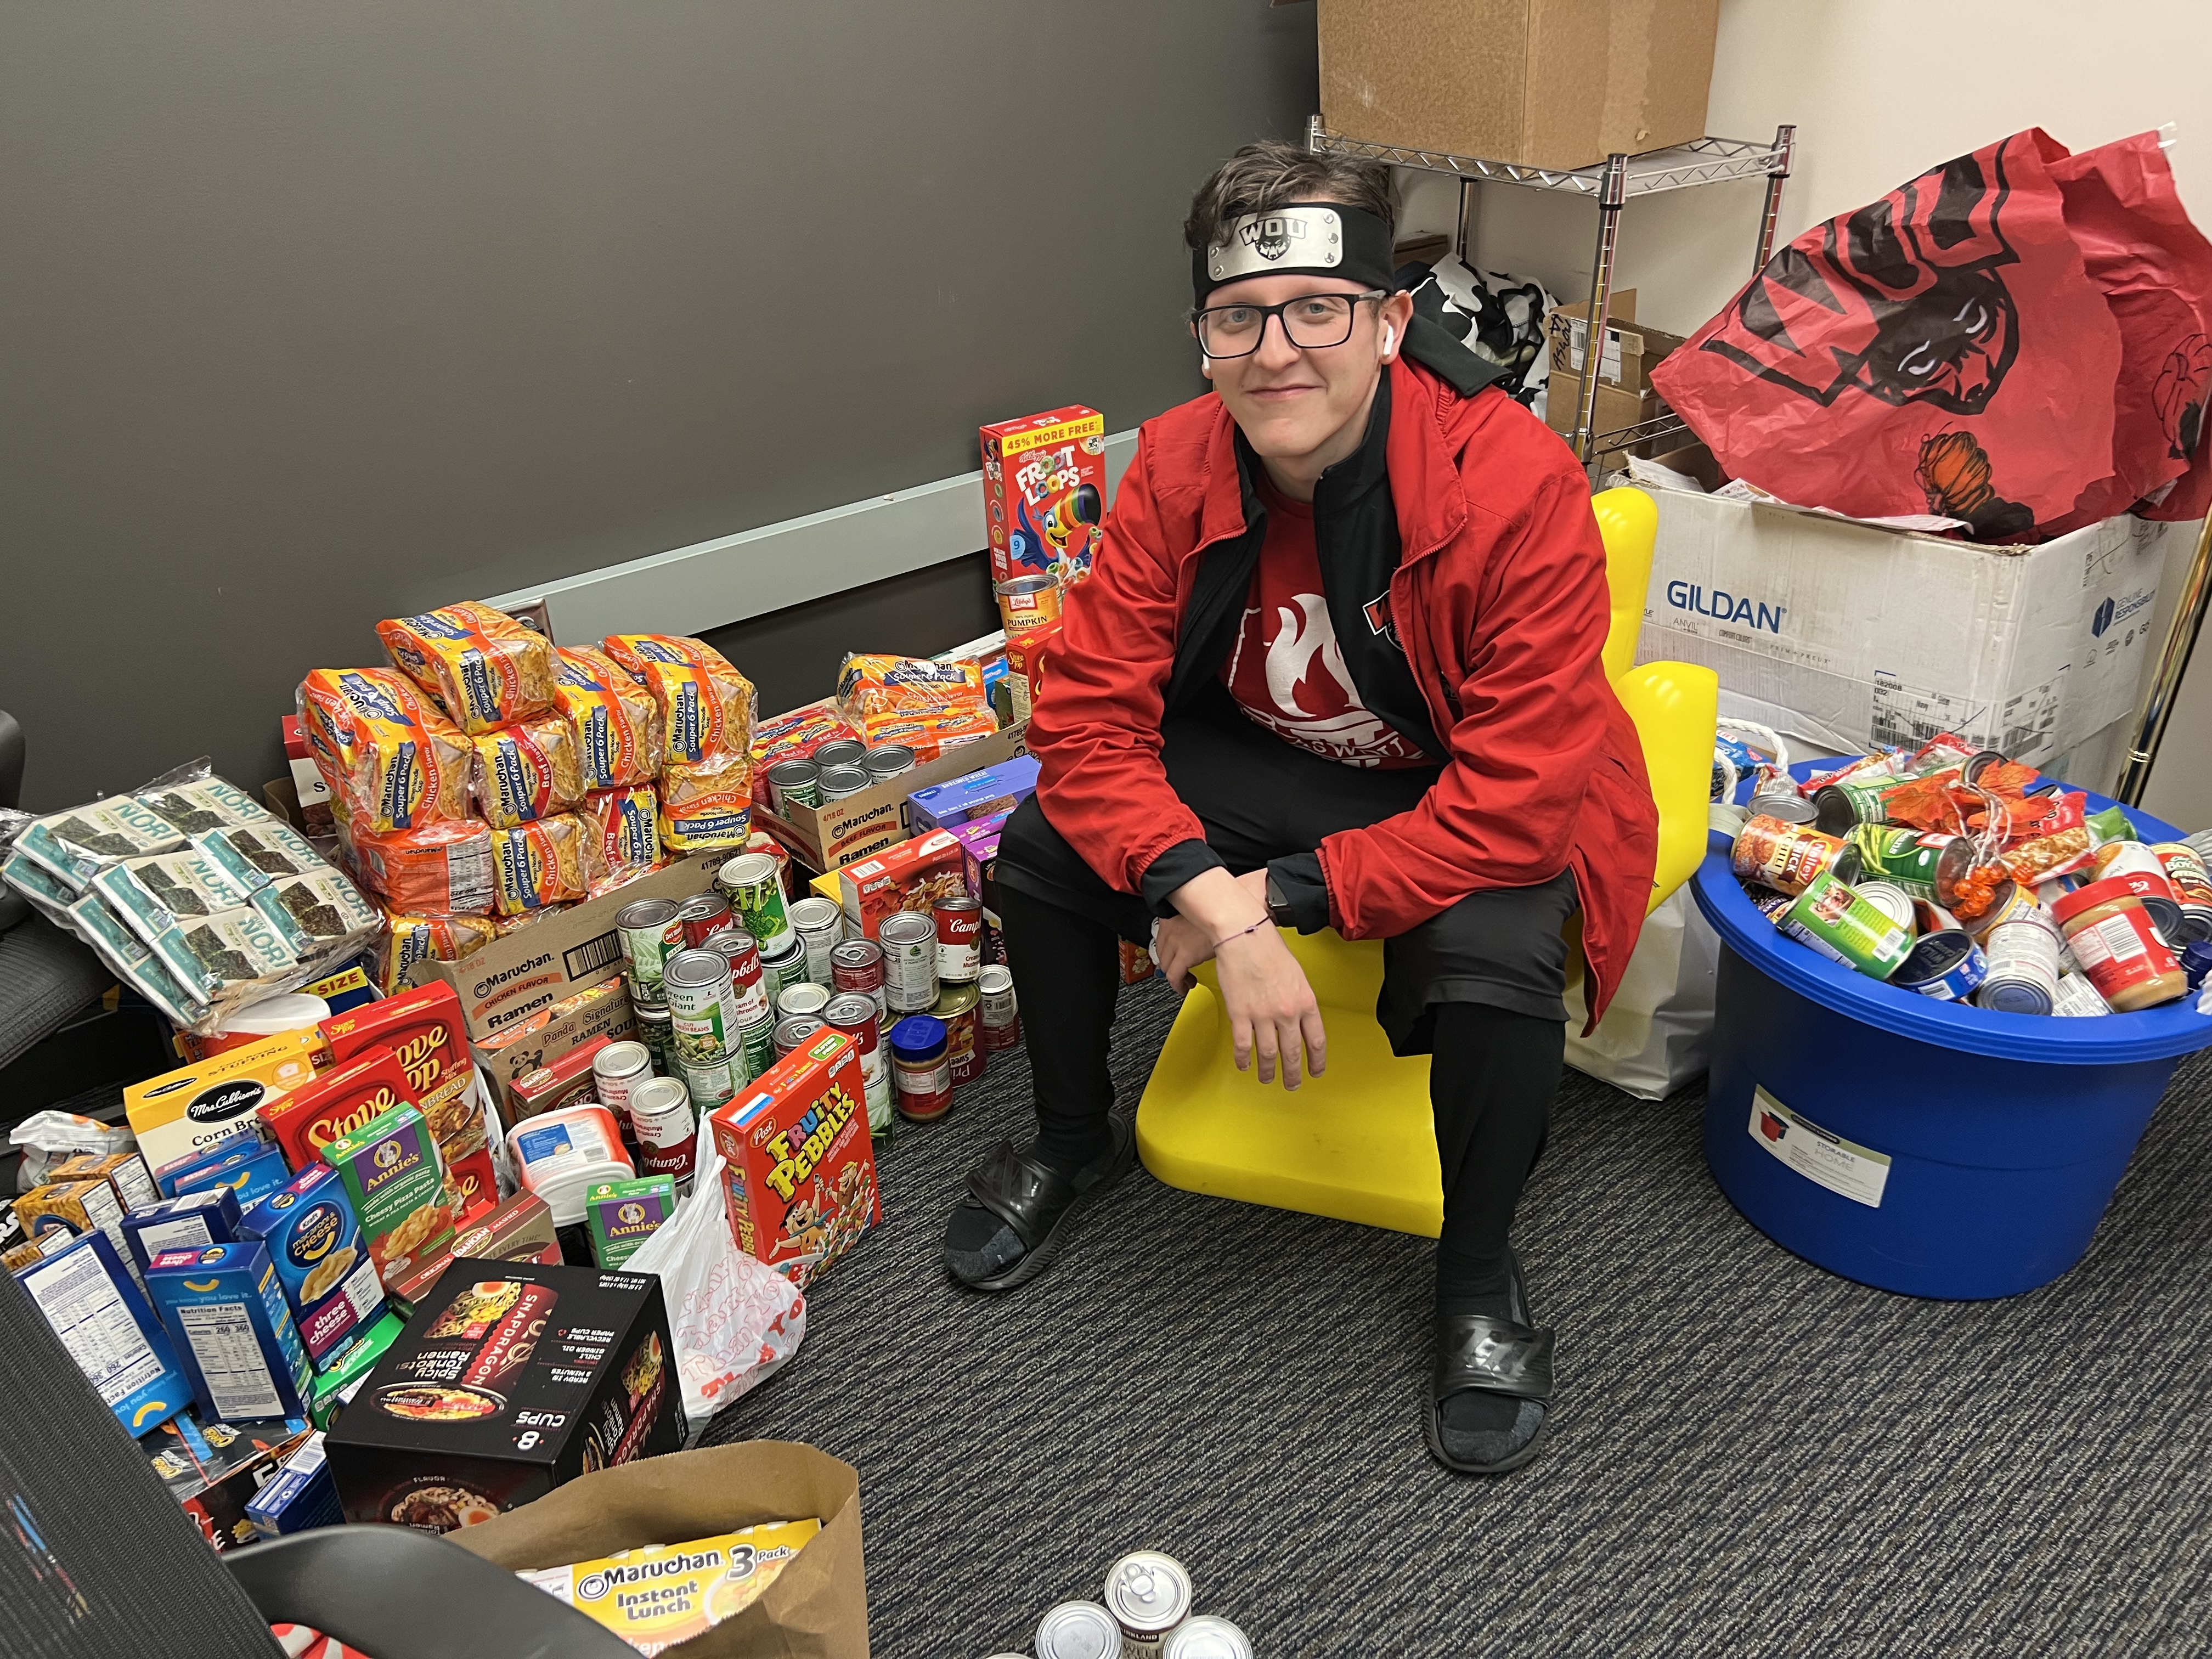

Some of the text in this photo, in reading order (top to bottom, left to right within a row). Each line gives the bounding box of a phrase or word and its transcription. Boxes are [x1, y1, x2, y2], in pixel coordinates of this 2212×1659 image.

[1239, 217, 1307, 246] WOU
[1007, 437, 1030, 449] 45%
[1034, 428, 1064, 444] MORE
[1015, 445, 1075, 492] FROOT
[1019, 450, 1047, 462] Kellogg's
[1024, 466, 1080, 507] LOOPS
[1014, 540, 1020, 550] 9
[1007, 616, 1048, 627] PUMPKIN
[505, 663, 517, 699] Chicken
[476, 687, 493, 713] Souper
[687, 690, 696, 713] Pack
[706, 685, 723, 743] Chicken Flavor
[597, 715, 606, 738] Pack
[673, 694, 685, 742] Maruchan
[616, 709, 631, 769] Chicken Flavor
[689, 724, 697, 753] Souper
[421, 747, 438, 809] Chicken Flavor
[541, 765, 550, 788] Beef
[599, 748, 607, 780] Souper
[382, 756, 398, 805] Maruchan
[396, 785, 406, 819] Souper
[402, 753, 411, 775] Pack
[495, 755, 510, 806] Maruchan
[506, 749, 528, 812] Souper Pack
[207, 785, 268, 820] NORI
[701, 794, 737, 805] Chicken
[112, 804, 179, 840] NORI
[627, 809, 639, 842] Souper
[684, 820, 706, 830] Pack
[686, 830, 736, 840] Maruchan
[715, 814, 747, 827] Souper
[274, 829, 329, 867] NORI
[606, 832, 616, 857] Beef
[841, 825, 886, 847] BEEF FLAVOR
[839, 837, 889, 865] Ramen
[1774, 836, 1793, 868] CHILI
[1787, 840, 1808, 873] THICK
[1800, 840, 1826, 882] Nalley
[503, 840, 514, 893] Maruchan
[515, 837, 532, 899] Souper Pack
[545, 849, 557, 887] Chicken
[330, 876, 377, 923] NORI
[238, 919, 294, 968] NORI
[318, 972, 360, 996] SIZE
[484, 977, 549, 1009] CHICKEN FLAVOR
[488, 992, 554, 1029] Ramen
[668, 998, 696, 1011] Giant
[543, 995, 630, 1046] Panda Signature
[572, 1018, 611, 1045] RAMEN
[441, 1057, 467, 1079] Stuffing
[444, 1070, 458, 1082] Mix
[522, 1068, 552, 1088] IDAHOAN
[215, 1086, 262, 1109] Cubbison's
[192, 1122, 233, 1147] Corn
[753, 1120, 775, 1146] Post
[766, 1081, 842, 1163] FRUITY
[766, 1092, 856, 1203] PEBBLES
[1815, 1149, 1853, 1172] HOME
[1816, 1141, 1855, 1163] STORABLE
[367, 1153, 419, 1192] Annie's
[365, 1203, 393, 1222] Cheesy
[394, 1192, 414, 1206] Pizza
[414, 1178, 435, 1193] Pasta
[292, 1215, 330, 1249] macaroni
[301, 1209, 321, 1231] Kraft
[610, 1220, 661, 1237] Annie's
[420, 1210, 519, 1279] ORIGINAL IDAHOAN MASHED
[499, 1239, 521, 1254] EVERY
[309, 1308, 349, 1345] cheese
[314, 1299, 347, 1330] three
[462, 1293, 538, 1386] SNAPDRAGON
[416, 1350, 472, 1363] Ramen
[128, 1367, 161, 1390] Nutrition
[414, 1367, 458, 1380] Spicy
[516, 1411, 566, 1427] CUPS
[517, 1430, 540, 1451] 8
[605, 1545, 791, 1584] Maruchan 3 Pack
[617, 1581, 698, 1608] Instant
[627, 1600, 692, 1621] Lunch
